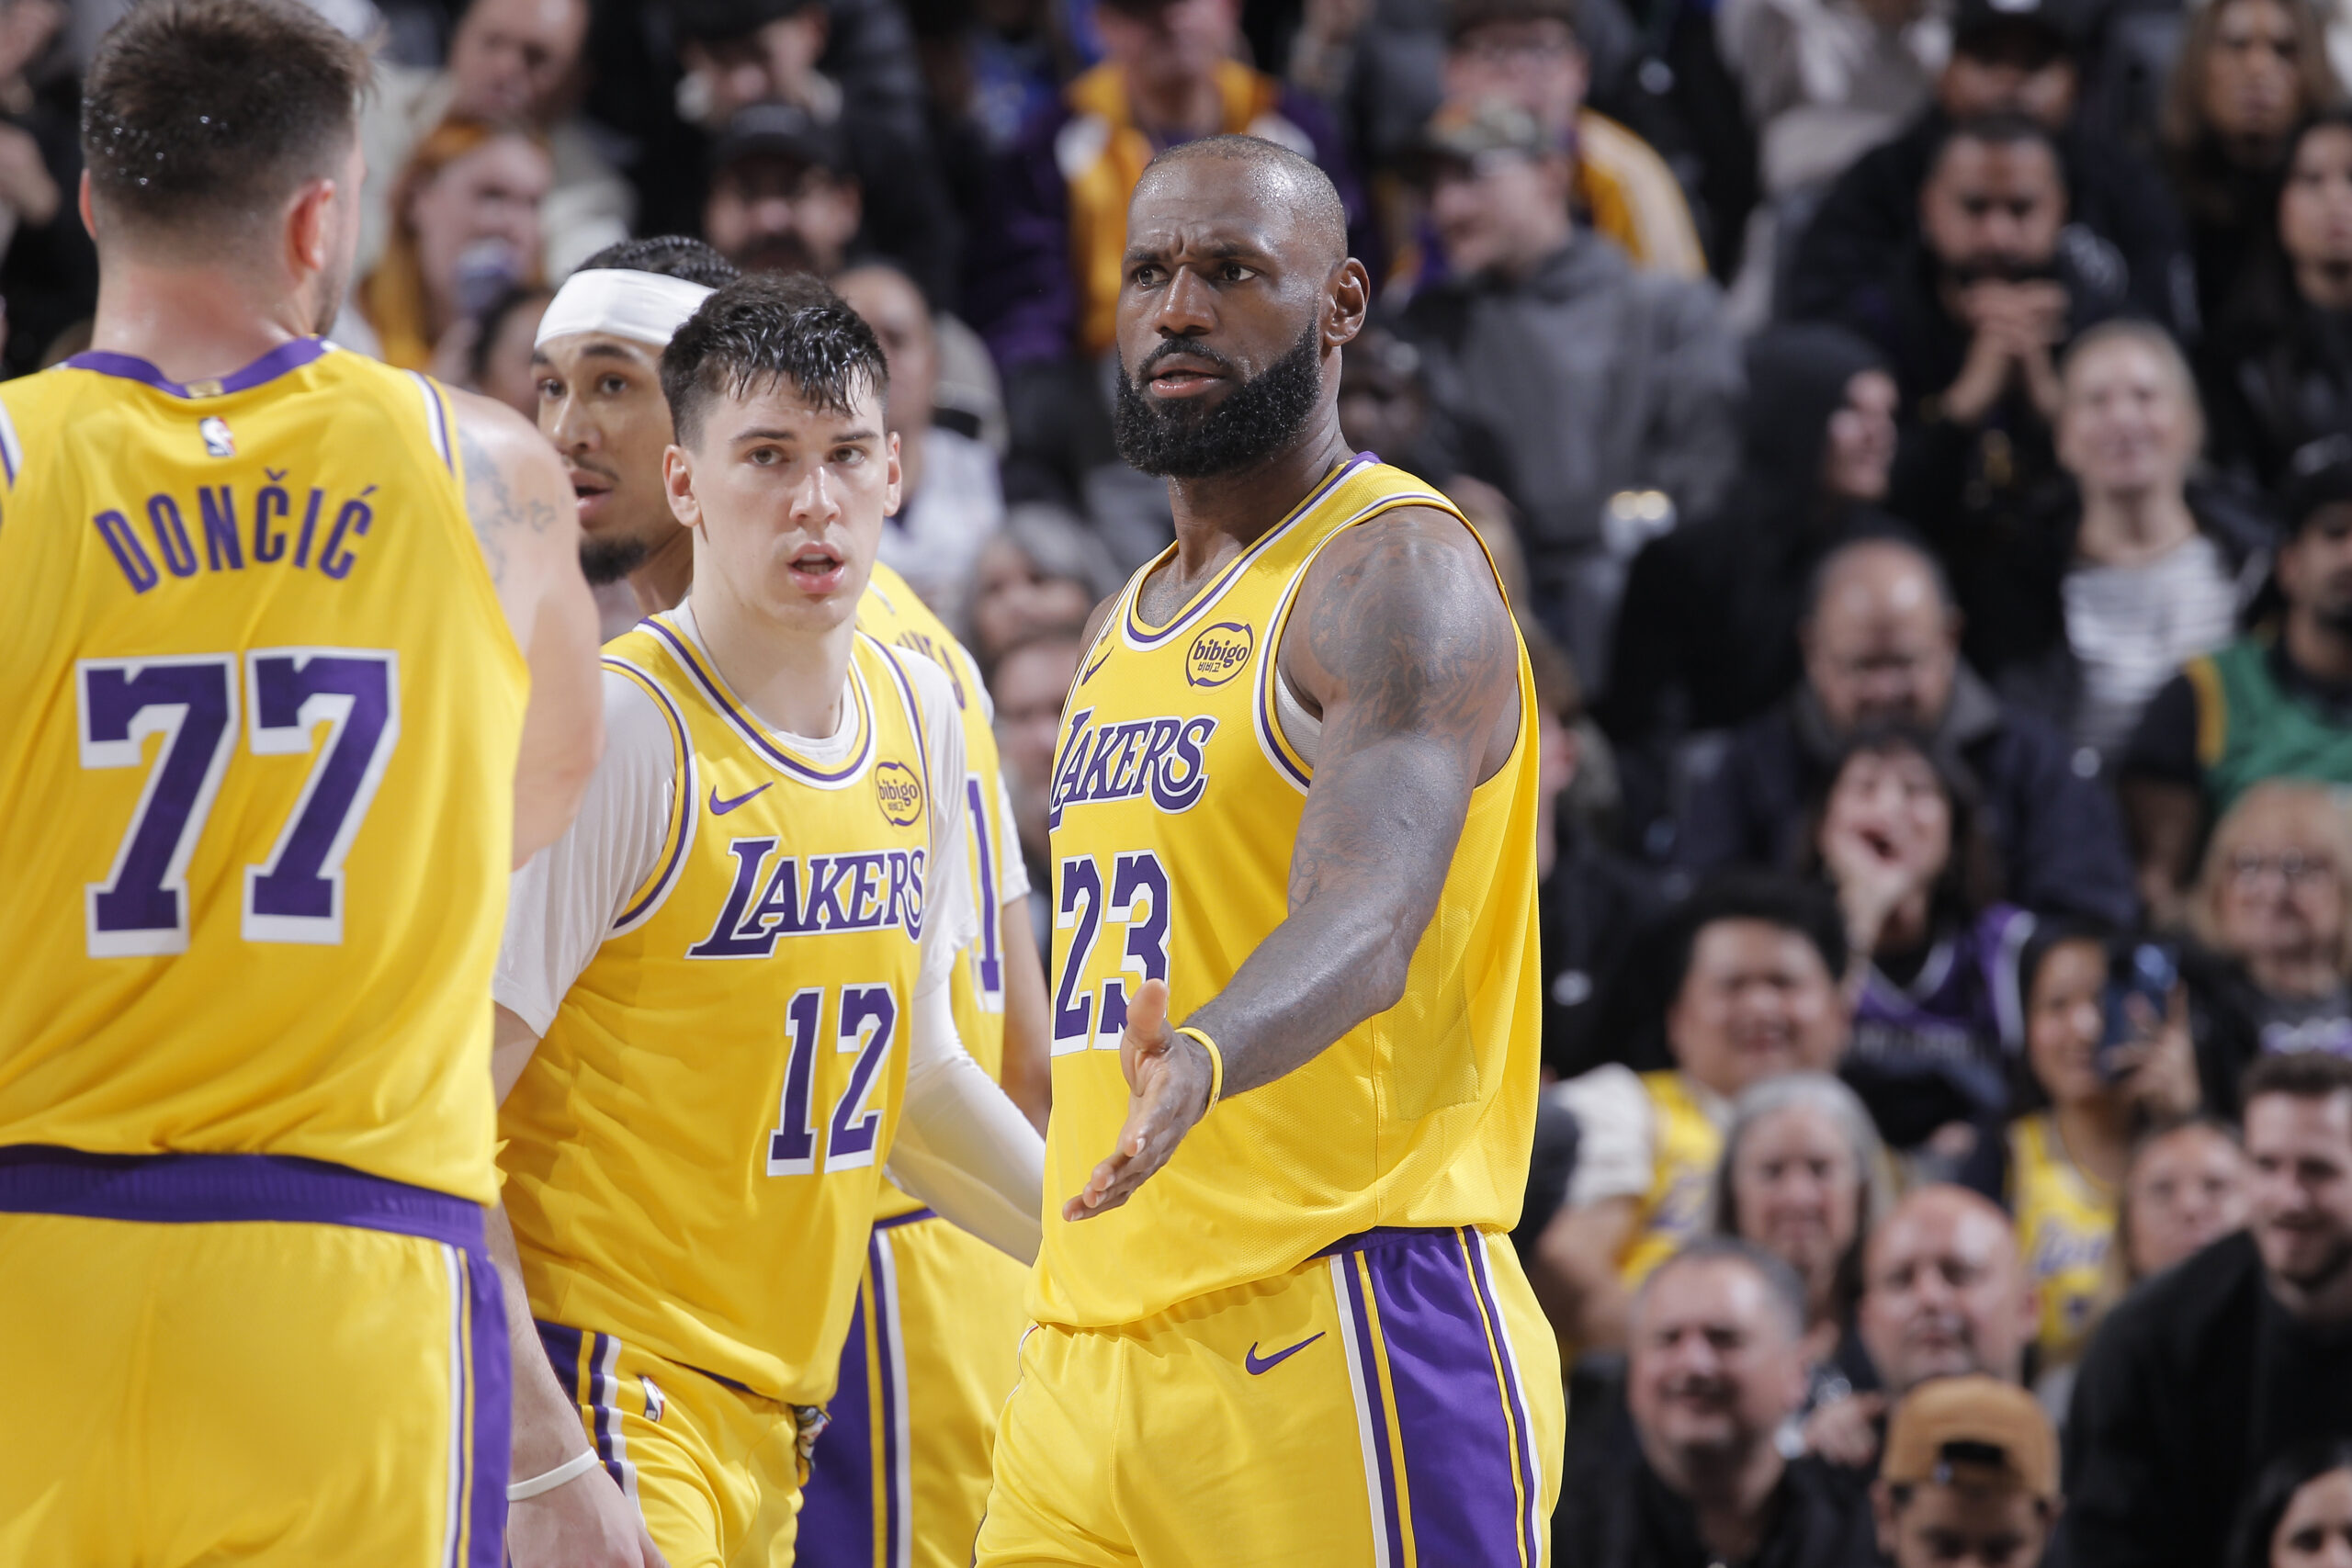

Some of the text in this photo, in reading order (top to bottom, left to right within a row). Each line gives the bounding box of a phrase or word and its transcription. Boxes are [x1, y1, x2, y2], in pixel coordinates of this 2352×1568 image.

[94, 468, 378, 594] DONČIĆ
[1193, 638, 1248, 669] bibigo
[1197, 661, 1221, 672] 비비고
[77, 647, 401, 957] 77
[877, 778, 918, 807] bibigo
[1049, 706, 1218, 832] LAKERS
[685, 837, 926, 959] LAKERS
[1050, 849, 1170, 1056] 23
[768, 983, 898, 1176] 12
